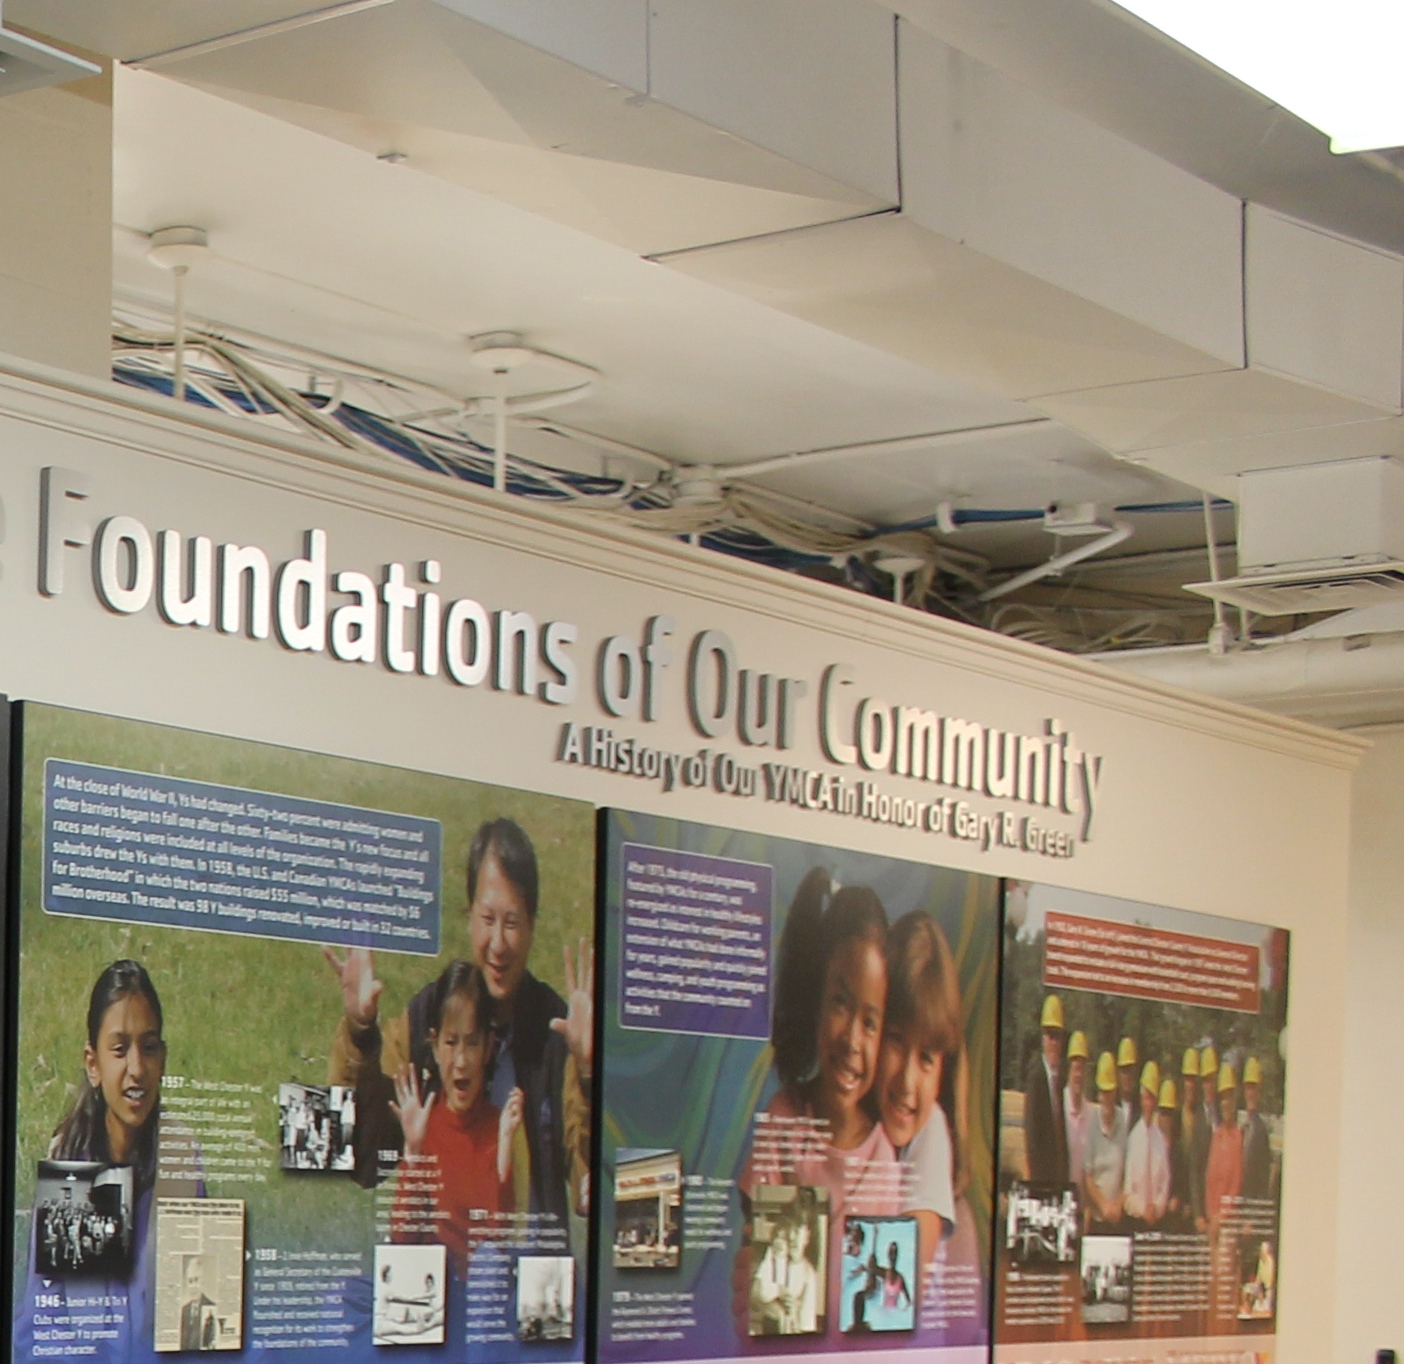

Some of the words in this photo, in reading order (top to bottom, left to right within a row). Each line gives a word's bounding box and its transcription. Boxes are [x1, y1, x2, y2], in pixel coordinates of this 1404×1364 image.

[37, 465, 577, 705] Foundations
[597, 614, 674, 722] of
[689, 629, 808, 750] Our
[819, 662, 1103, 842] Community
[554, 722, 584, 763] A
[583, 725, 683, 793] History
[681, 749, 713, 787] of
[762, 762, 834, 810] YMCA
[832, 776, 857, 815] in
[858, 781, 924, 828] Honor
[922, 798, 952, 834] of
[949, 801, 996, 851] Gary
[1022, 815, 1074, 858] Green
